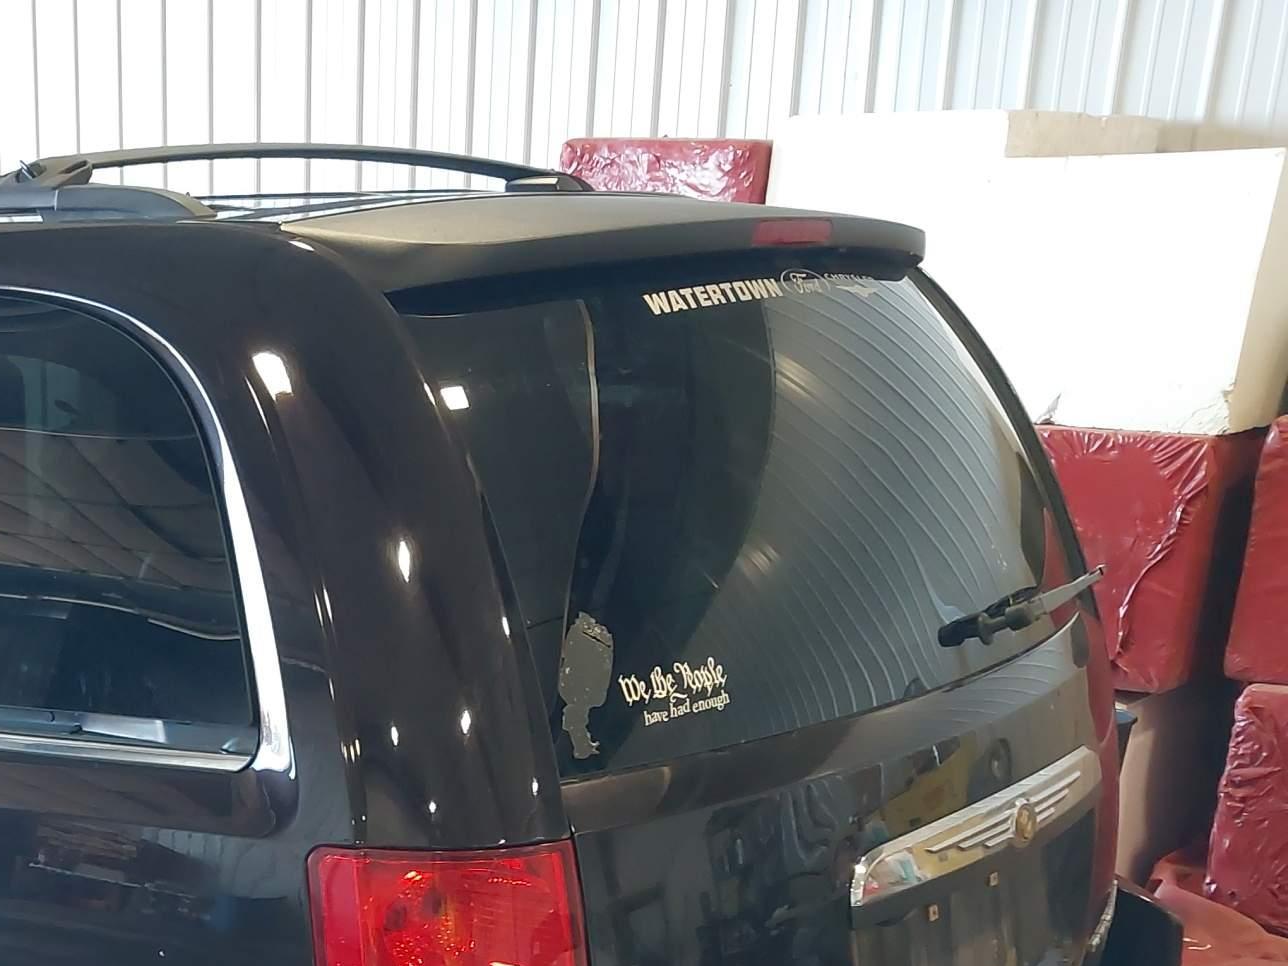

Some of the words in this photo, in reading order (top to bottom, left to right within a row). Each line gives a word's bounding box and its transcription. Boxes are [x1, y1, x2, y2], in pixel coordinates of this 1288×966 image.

[642, 278, 784, 315] WATERTOWN
[619, 674, 652, 706] We
[673, 657, 728, 697] People
[643, 710, 670, 727] have
[669, 698, 691, 719] had
[691, 690, 731, 713] enough
